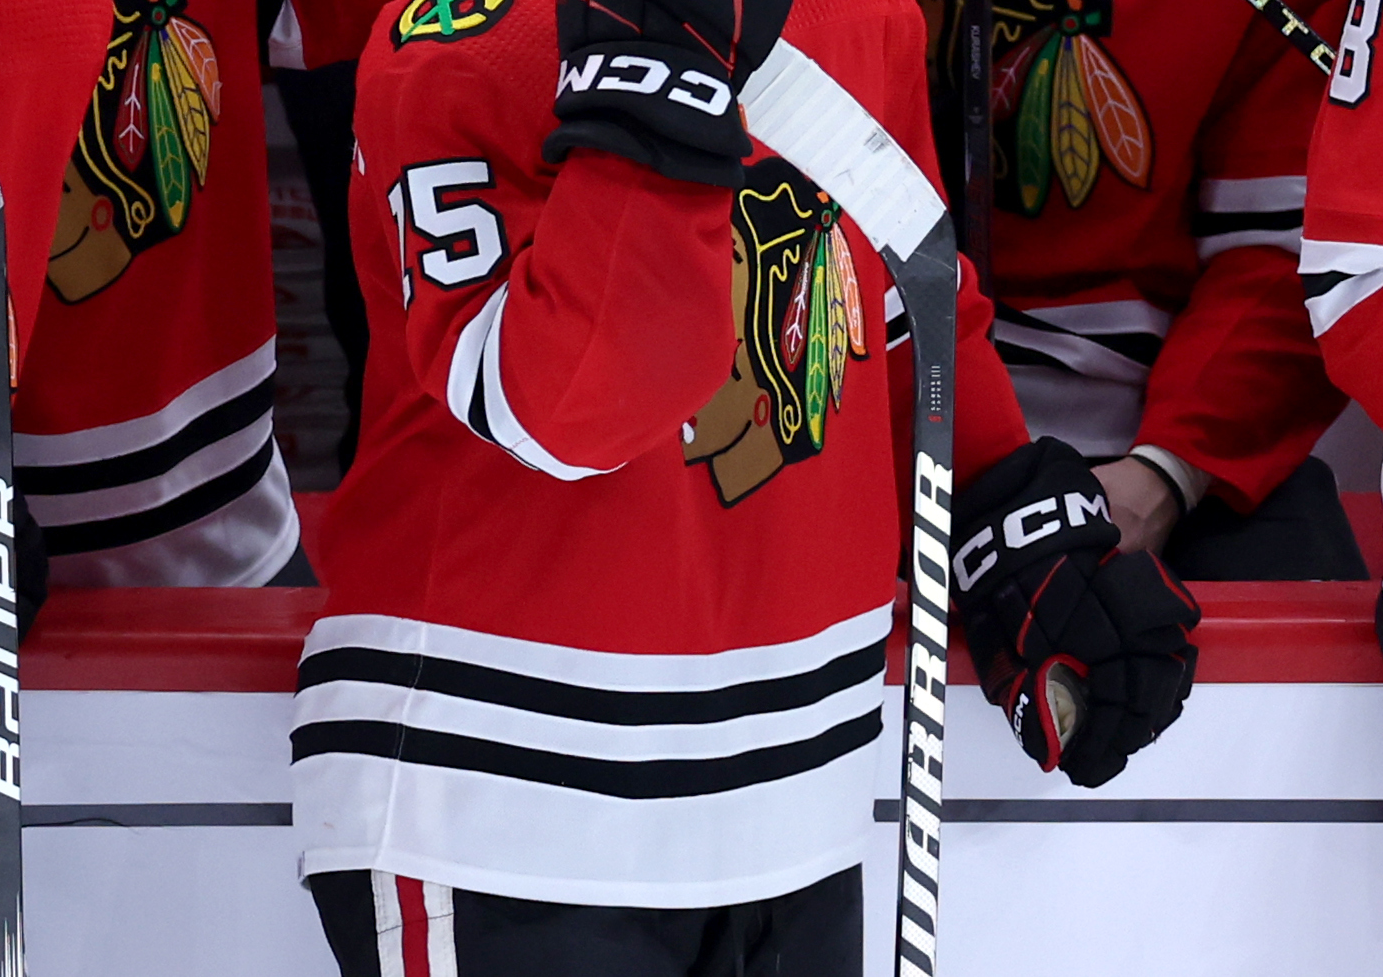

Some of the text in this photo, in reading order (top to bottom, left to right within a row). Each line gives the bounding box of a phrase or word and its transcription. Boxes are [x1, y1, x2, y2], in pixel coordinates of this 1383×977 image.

[555, 54, 732, 117] CCM
[952, 491, 1112, 593] CCM
[899, 451, 953, 977] WARRIOR
